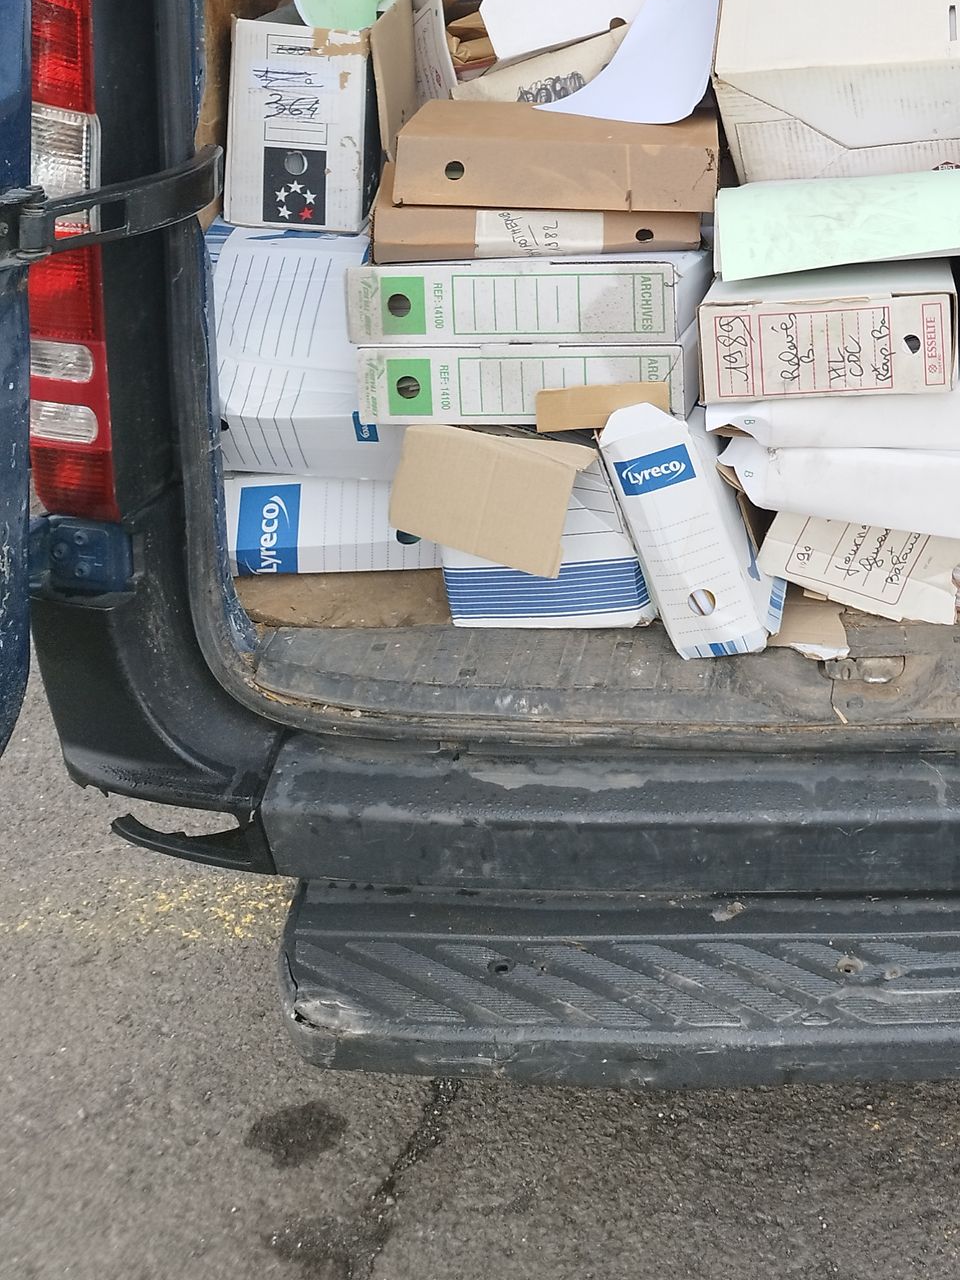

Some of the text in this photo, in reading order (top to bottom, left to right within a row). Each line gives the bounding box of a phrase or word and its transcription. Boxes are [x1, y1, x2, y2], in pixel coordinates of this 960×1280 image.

[433, 282, 444, 330] REF: 14100
[640, 275, 653, 331] ARCHIVES
[716, 316, 755, 382] 1989
[925, 316, 938, 360] ESSELTE
[440, 364, 451, 411] REF: 14100
[647, 358, 659, 381] ARC
[626, 459, 684, 486] Lyreco
[253, 497, 285, 574] Lyreco
[835, 524, 867, 576] Journa
